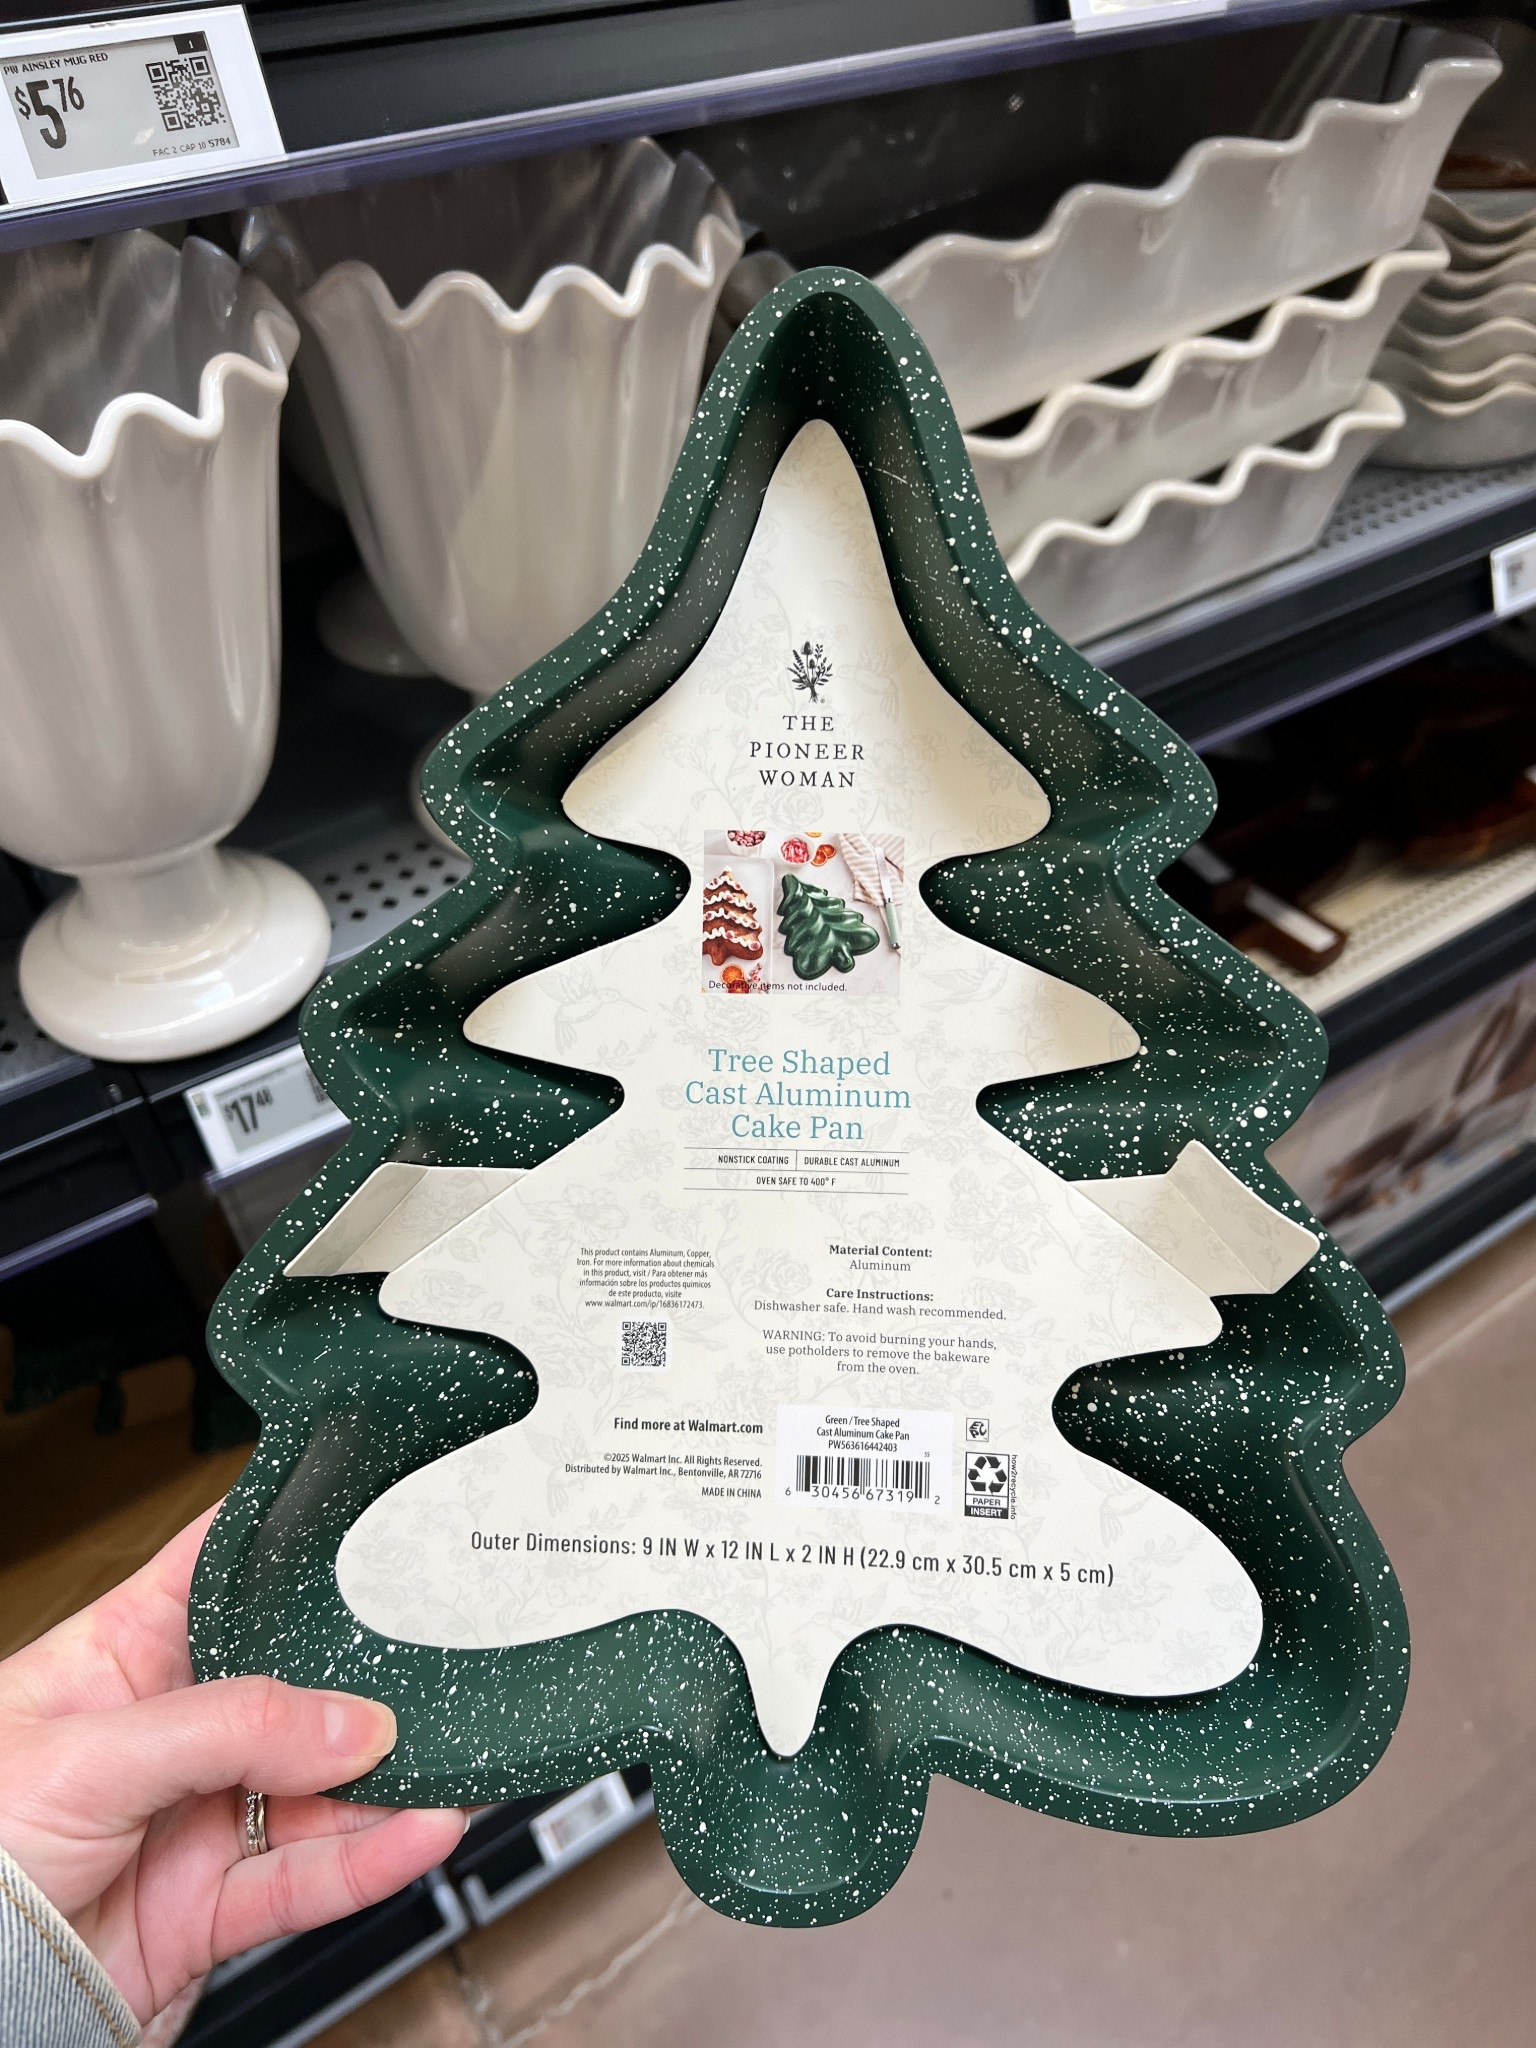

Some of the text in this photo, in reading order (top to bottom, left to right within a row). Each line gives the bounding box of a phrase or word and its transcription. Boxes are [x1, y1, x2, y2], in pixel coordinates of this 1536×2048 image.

[3, 52, 108, 75] PW AINSLEY MUG RED
[152, 137, 232, 157] FAC 2 CAP 10 5784
[782, 715, 835, 732] THE
[750, 742, 865, 760] PIONEER
[758, 770, 856, 788] WOMAN
[708, 980, 848, 992] Decorative items not included.
[708, 1048, 890, 1080] Tree Shaped
[686, 1080, 912, 1108] Cast Aluminum
[732, 1114, 864, 1140] Cake Pan
[718, 1155, 789, 1165] NONSTICK COATING
[804, 1157, 900, 1167] DURABLE CAST ALUMINUM
[756, 1176, 776, 1185] OVEN
[778, 1177, 797, 1186] SAFE
[800, 1177, 809, 1186] TO
[831, 1178, 836, 1186] F
[595, 1248, 620, 1257] product
[622, 1248, 648, 1256] contains
[650, 1248, 685, 1258] Aluminum,
[687, 1249, 711, 1259] Copper,
[829, 1244, 933, 1258] Material Content:
[577, 1258, 592, 1266] Iron.
[594, 1258, 604, 1266] For
[624, 1258, 661, 1267] information
[663, 1259, 682, 1267] about
[683, 1260, 715, 1268] chemicals
[850, 1260, 911, 1271] Aluminum
[584, 1268, 589, 1276] in
[591, 1268, 603, 1276] this
[605, 1269, 631, 1278] product,
[633, 1269, 646, 1277] visit
[652, 1269, 666, 1277] Para
[668, 1269, 693, 1277] obtener
[695, 1270, 708, 1278] más
[620, 1279, 637, 1287] sobre
[639, 1279, 648, 1287] los
[650, 1279, 681, 1289] productos
[633, 1289, 663, 1299] producto,
[665, 1290, 682, 1298] visite
[826, 1288, 934, 1302] Care Instructions:
[754, 1300, 1007, 1320] Dishwasher safe. Hand wash recommended.
[763, 1329, 997, 1350] WARNING: To avoid burning your hands,
[766, 1345, 990, 1364] use potholders to remove the bakeware
[837, 1361, 919, 1375] from the oven.
[614, 1418, 763, 1434] Find more at Walmart.com
[826, 1415, 847, 1424] Green
[854, 1416, 870, 1426] Tree
[871, 1417, 900, 1429] Shaped
[817, 1427, 910, 1440] Cast Aluminum Cake Pan
[604, 1453, 762, 1467] ©2025 Walmart Inc. All Rights Reserved.
[566, 1464, 762, 1479] Distributed by Walmart Inc., Bentonville, AR 72716
[702, 1487, 762, 1498] MADE IN CHINA
[1010, 1454, 1018, 1520] how2recycle.info
[785, 1486, 940, 1504] 6 30456 67319 2
[973, 1497, 1001, 1506] PAPER
[970, 1507, 1002, 1517] INSERT
[471, 1532, 1114, 1586] Outer Dimensions: 9 IN W x 12 IN L x 2 IN H (22.9 cm x 30.5 cm x 5 cm)
